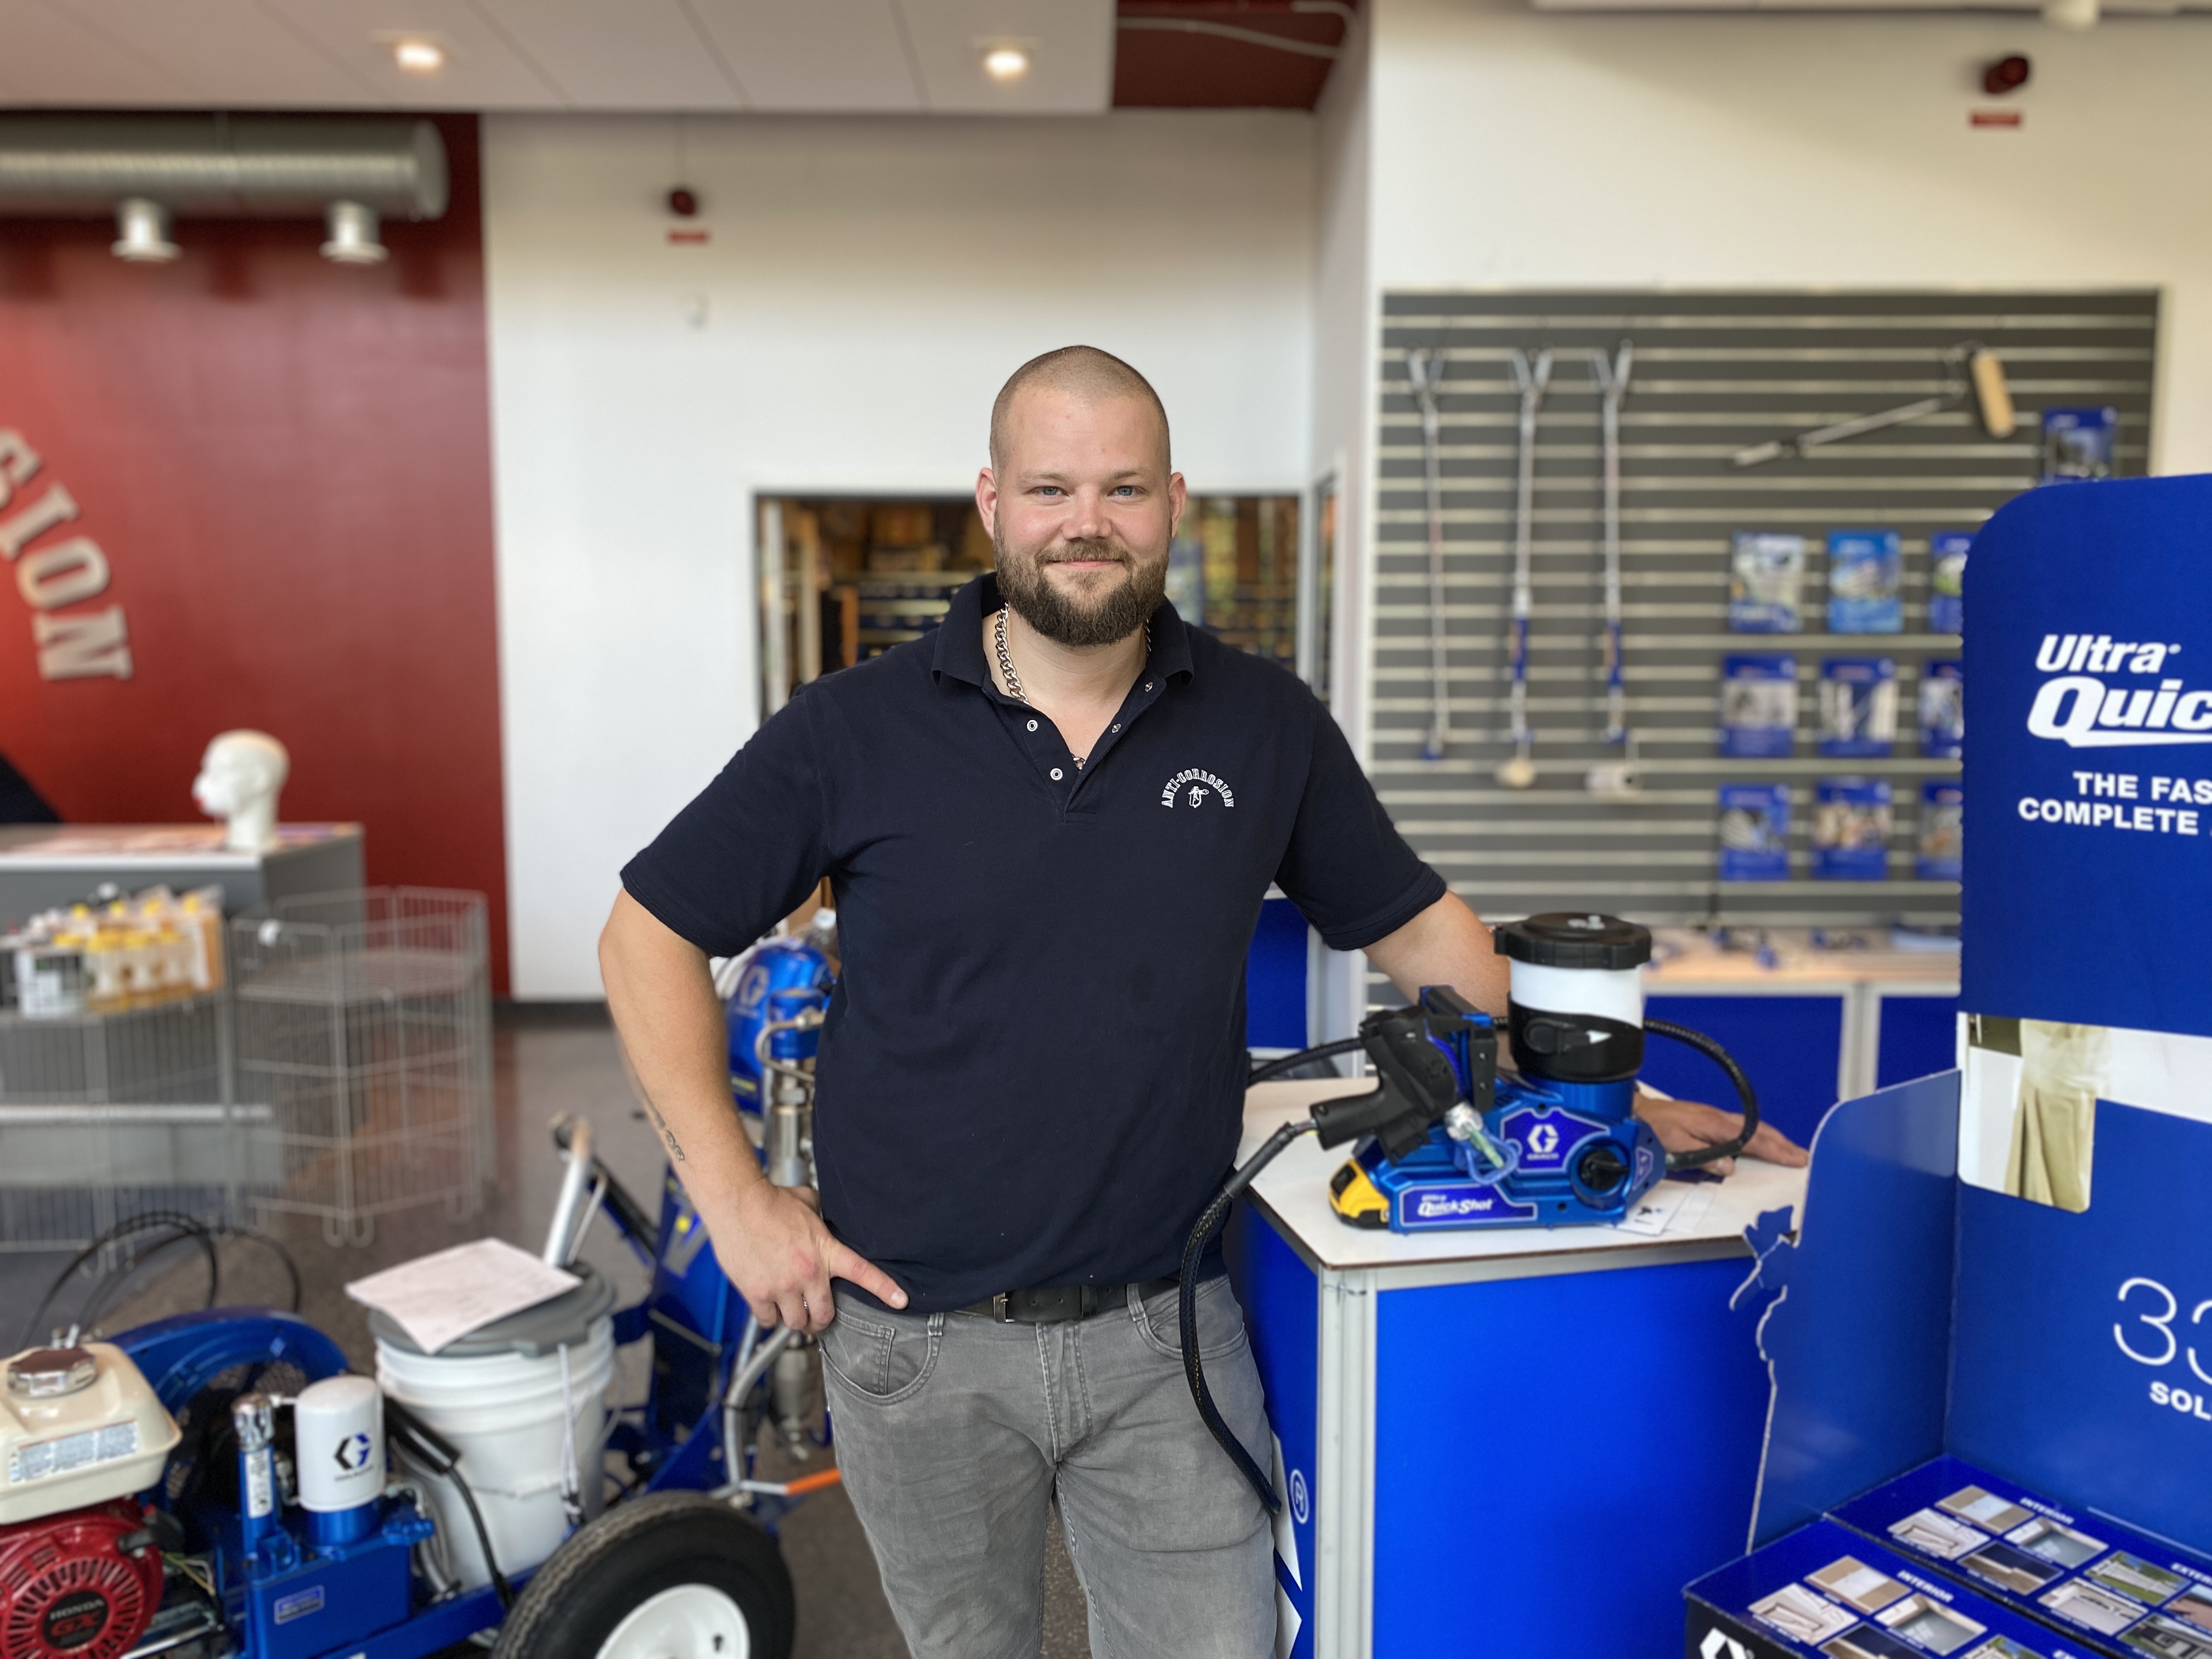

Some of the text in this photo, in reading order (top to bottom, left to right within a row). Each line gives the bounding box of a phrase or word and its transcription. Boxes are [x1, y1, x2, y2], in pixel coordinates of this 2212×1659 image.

[2027, 675, 2212, 748] Quic
[1161, 768, 1234, 808] ANTI-CORROSION
[2072, 770, 2212, 805] THE FAS
[2017, 797, 2199, 836] COMPLETE
[2149, 1380, 2212, 1421] SOL
[1897, 1570, 1954, 1603] INTERIOR
[49, 1599, 105, 1621] HONDA
